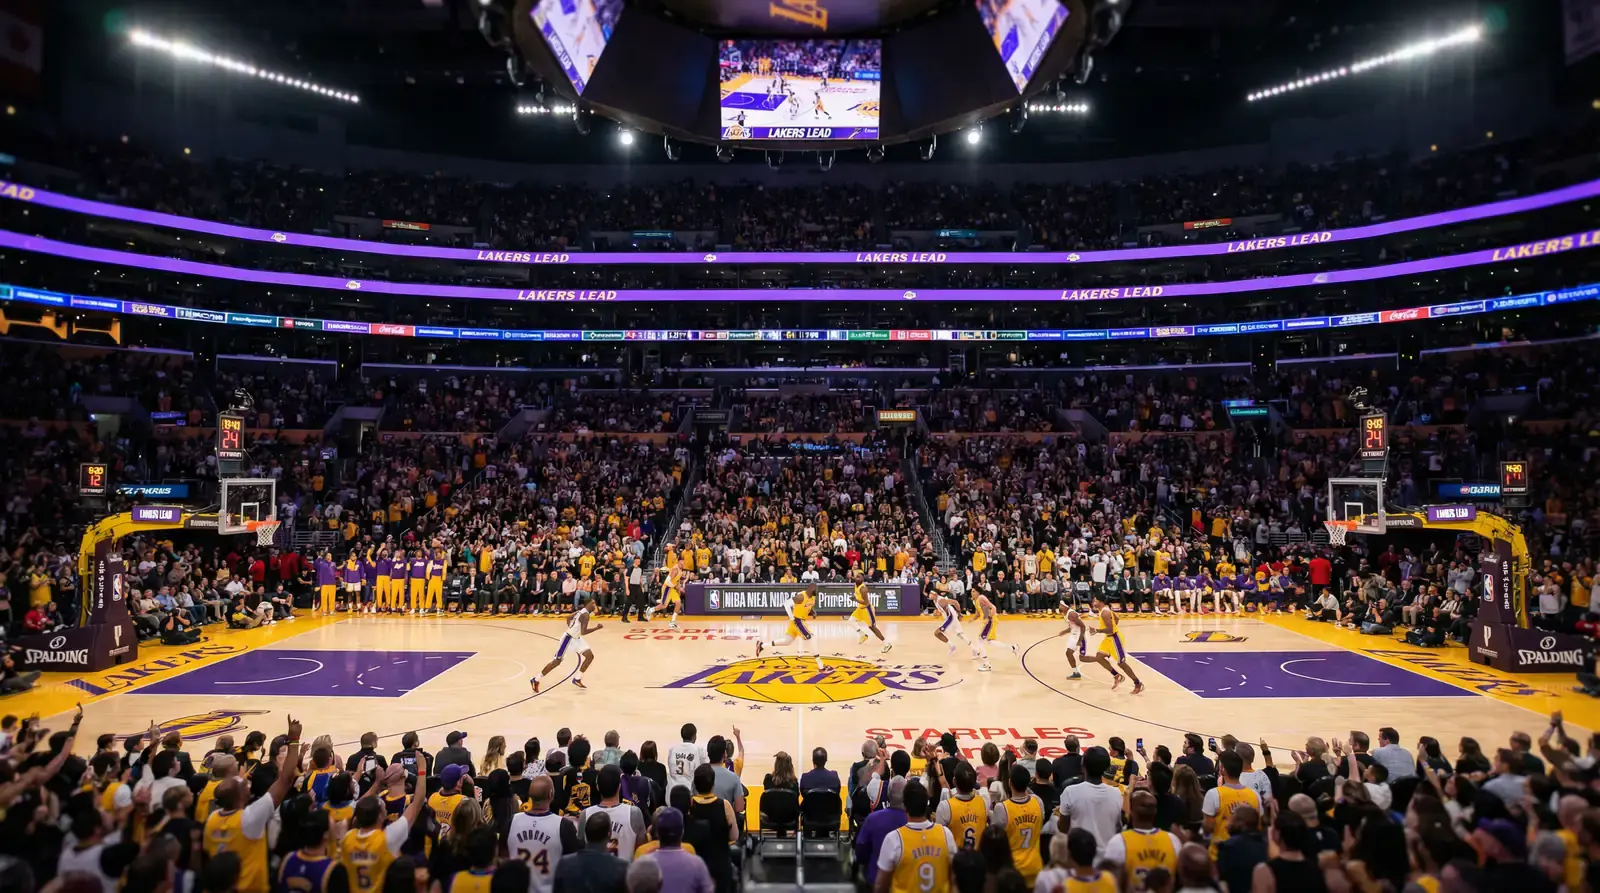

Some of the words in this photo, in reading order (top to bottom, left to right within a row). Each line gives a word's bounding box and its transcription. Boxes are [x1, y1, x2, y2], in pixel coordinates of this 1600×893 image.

[768, 127, 806, 138] LAKERS
[806, 127, 832, 138] LEAD
[1227, 237, 1286, 253] LAKERS
[1291, 232, 1332, 246] LEAD
[1492, 236, 1573, 262] LAKERS
[477, 250, 531, 262] LAKERS
[534, 253, 570, 263] LEAD
[856, 252, 908, 263] LAKERS
[911, 252, 947, 263] LEAD
[517, 290, 576, 301] LAKERS
[579, 290, 617, 301] LEAD
[1060, 288, 1119, 301] LAKERS
[1123, 286, 1163, 298] LEAD
[223, 430, 239, 448] 24
[1366, 430, 1382, 448] 24
[24, 648, 89, 666] SPALDING
[1518, 648, 1585, 666] SPALDING
[64, 645, 250, 698] LAKERS
[645, 664, 965, 692] LAKERS
[1019, 827, 1033, 849] 7
[356, 865, 372, 890] 6
[918, 862, 935, 892] 9
